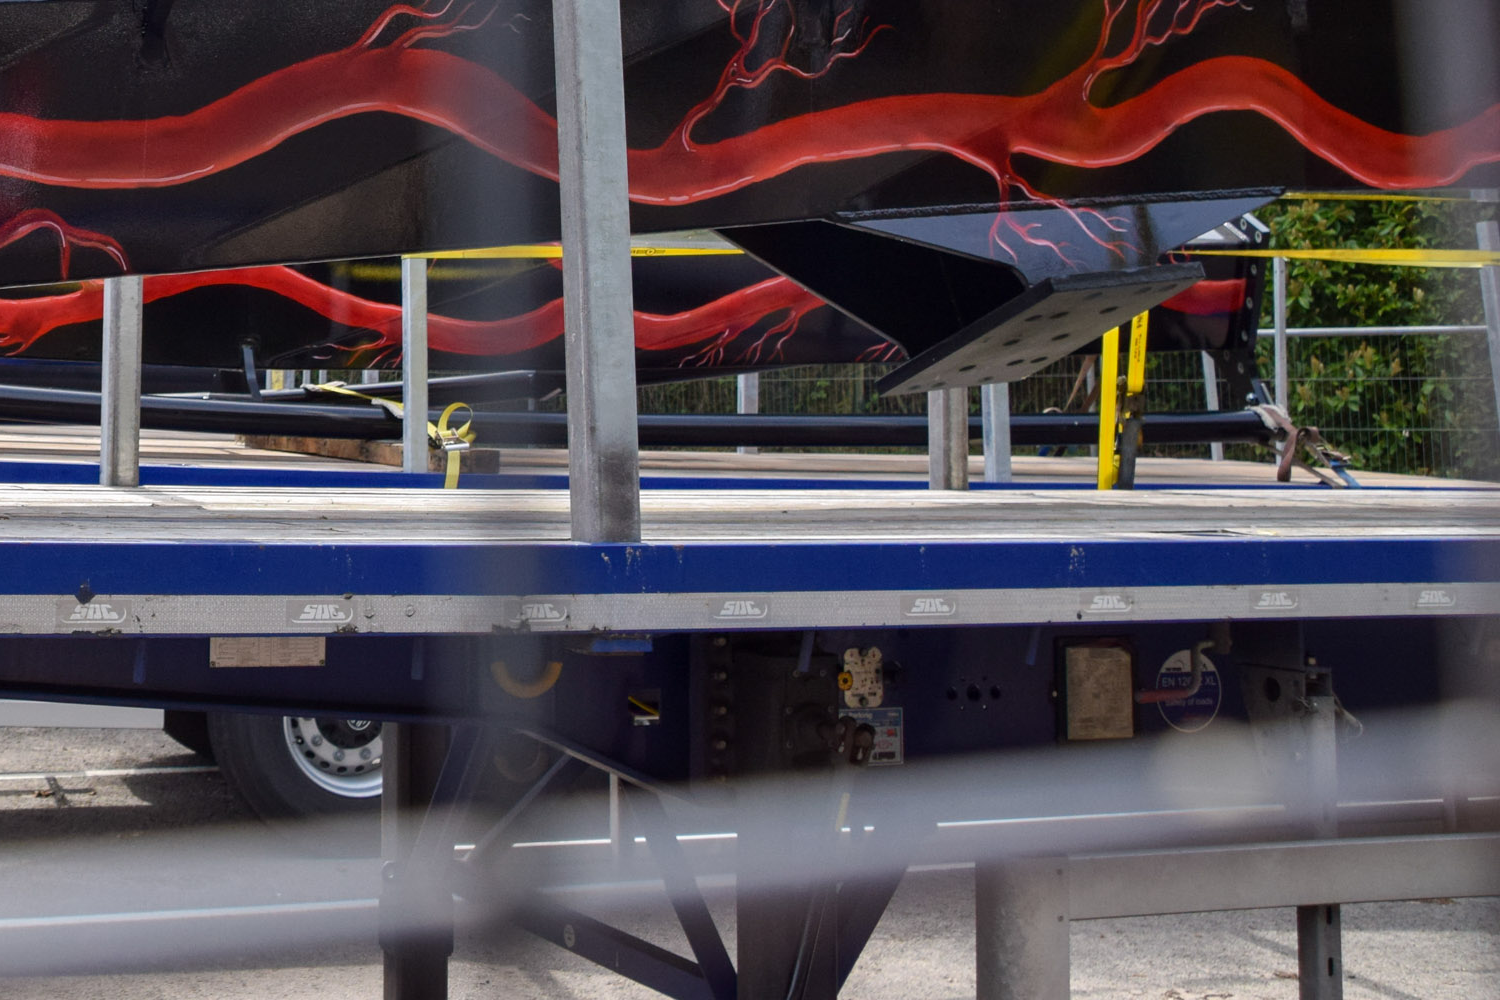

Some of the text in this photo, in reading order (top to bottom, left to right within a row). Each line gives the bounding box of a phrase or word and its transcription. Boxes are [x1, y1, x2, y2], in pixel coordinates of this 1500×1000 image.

[910, 598, 951, 613] SDC
[1089, 595, 1128, 609] SDC
[1257, 591, 1294, 606] SDC
[70, 603, 120, 620] SDC
[299, 603, 346, 620] SDC
[719, 600, 763, 616] SDC
